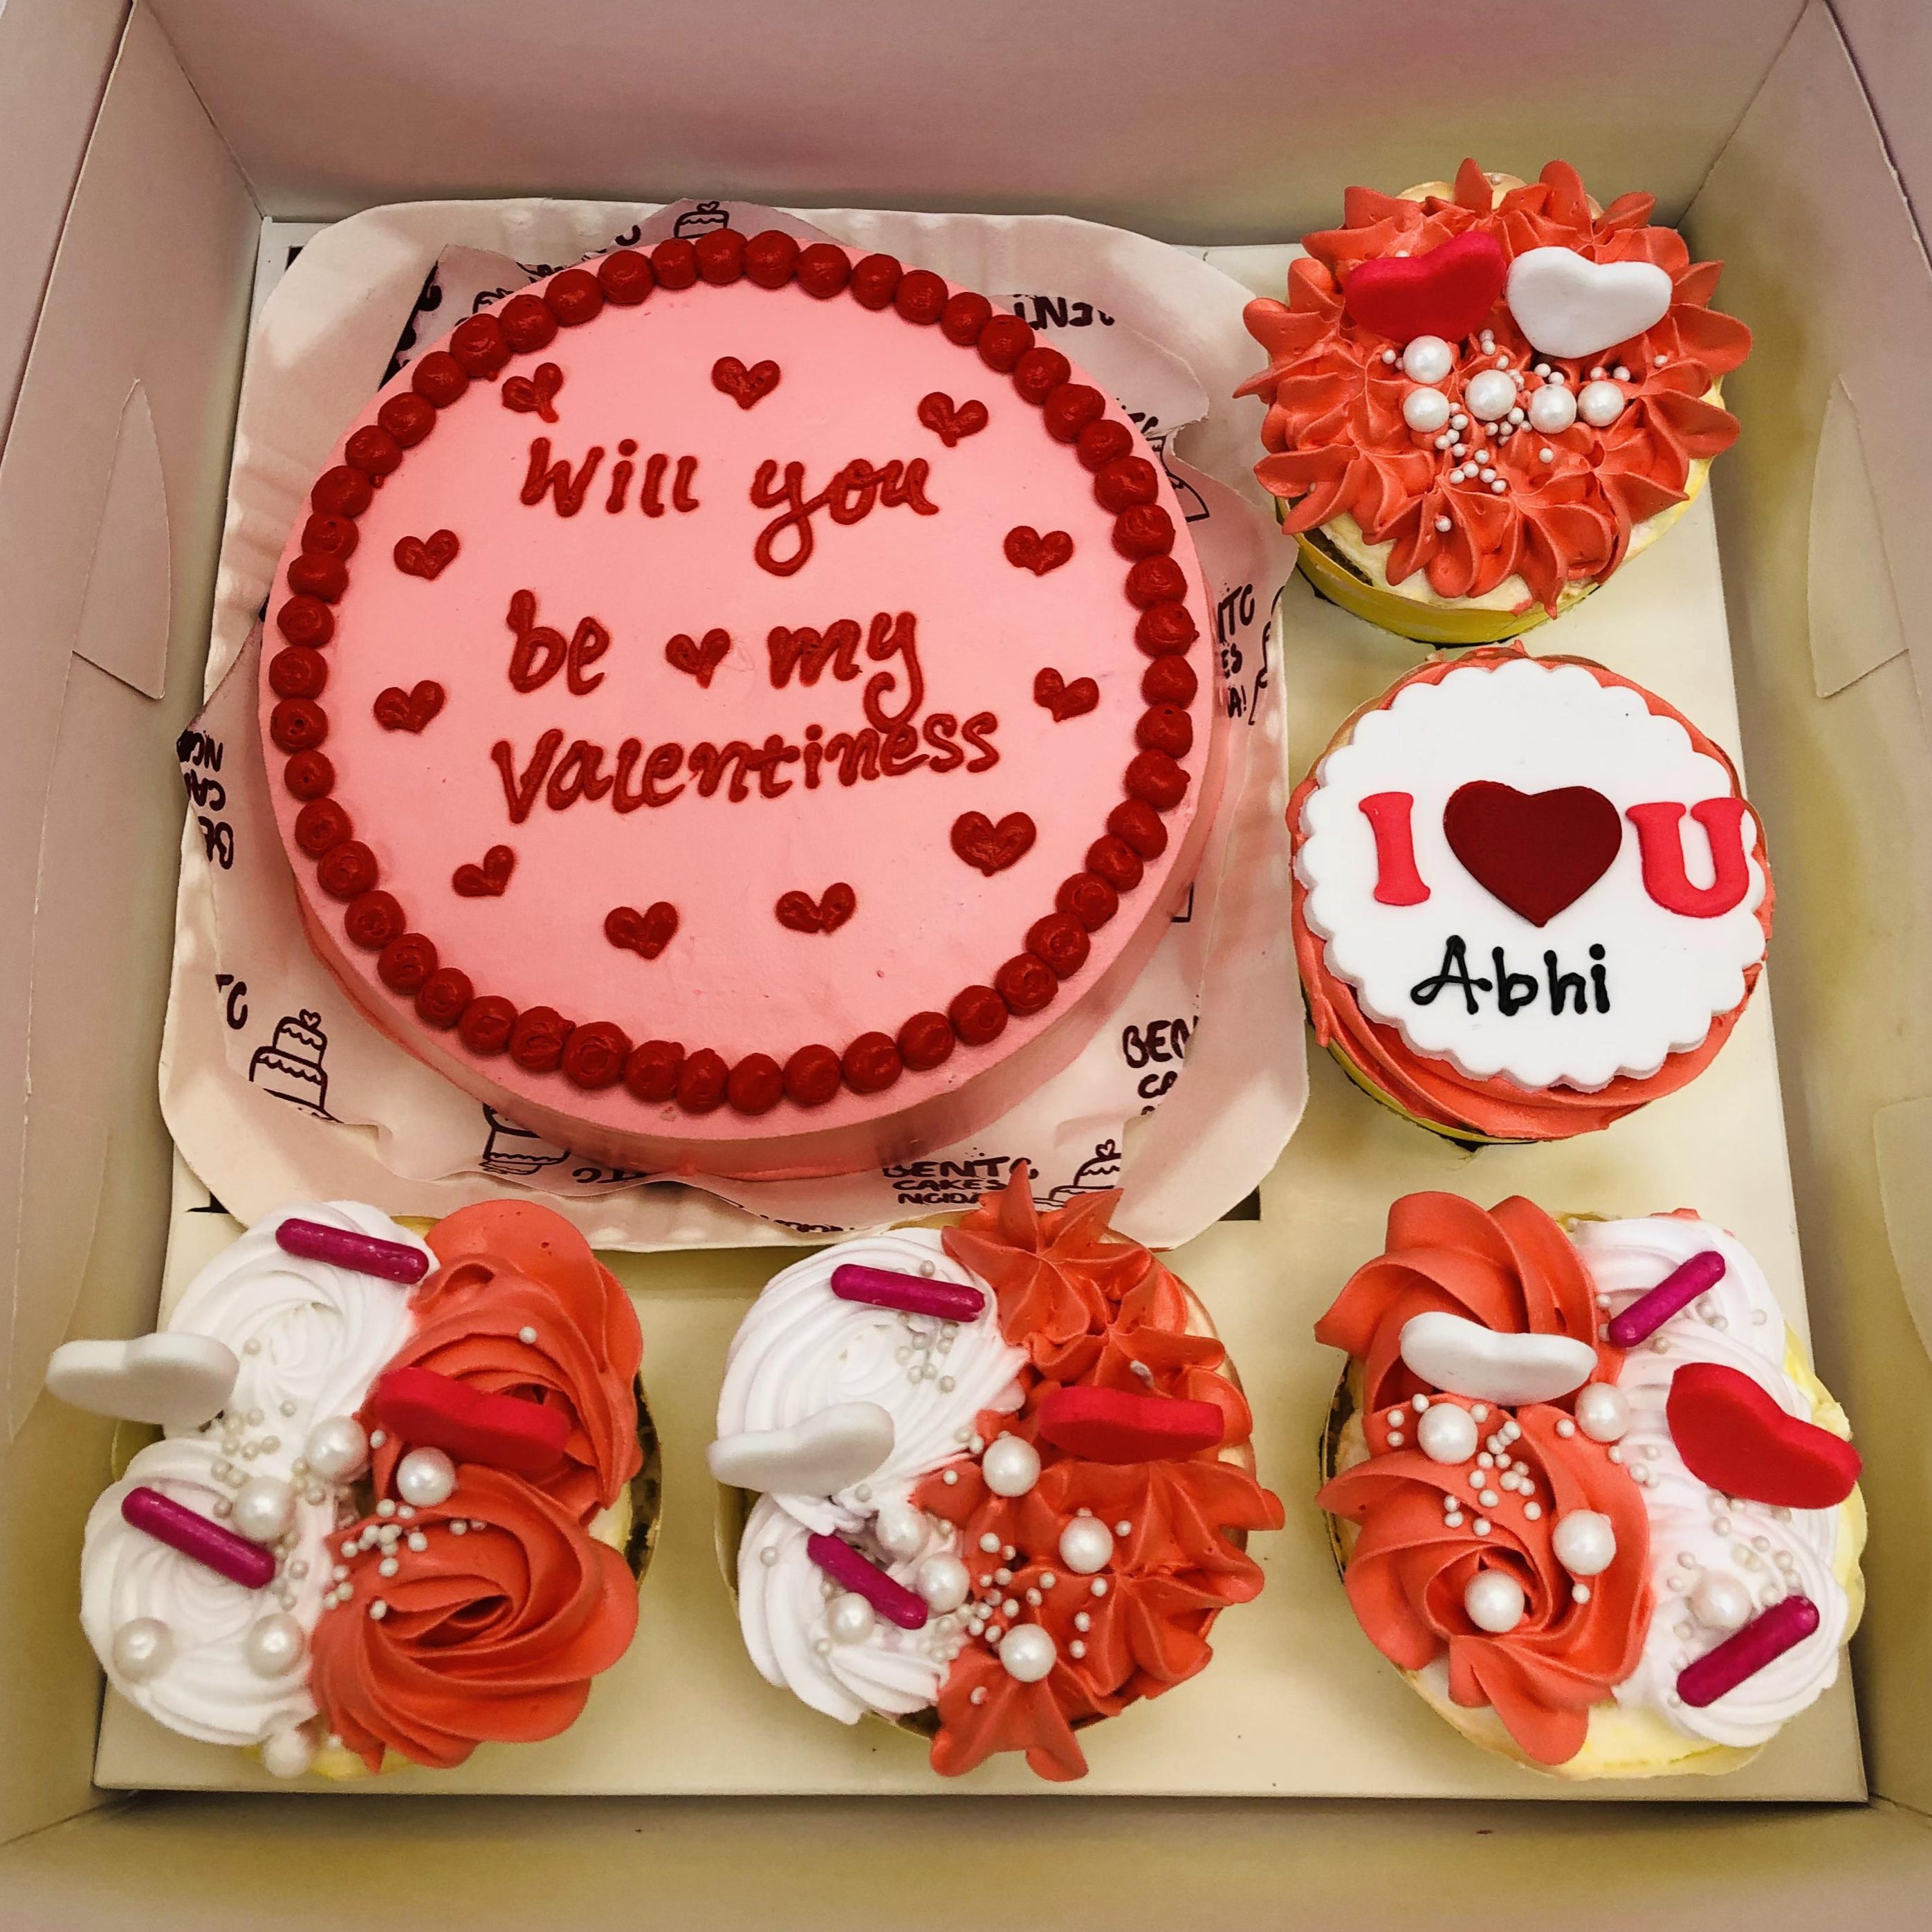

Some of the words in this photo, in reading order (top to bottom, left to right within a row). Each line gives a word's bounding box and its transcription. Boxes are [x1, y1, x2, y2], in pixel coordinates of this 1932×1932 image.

[750, 457, 939, 577] you
[506, 589, 611, 696] be
[766, 611, 930, 733] my
[1358, 791, 1431, 907] I
[1625, 798, 1750, 919] U
[1410, 935, 1611, 1017] Abhi
[892, 1178, 1008, 1192] CAKES
